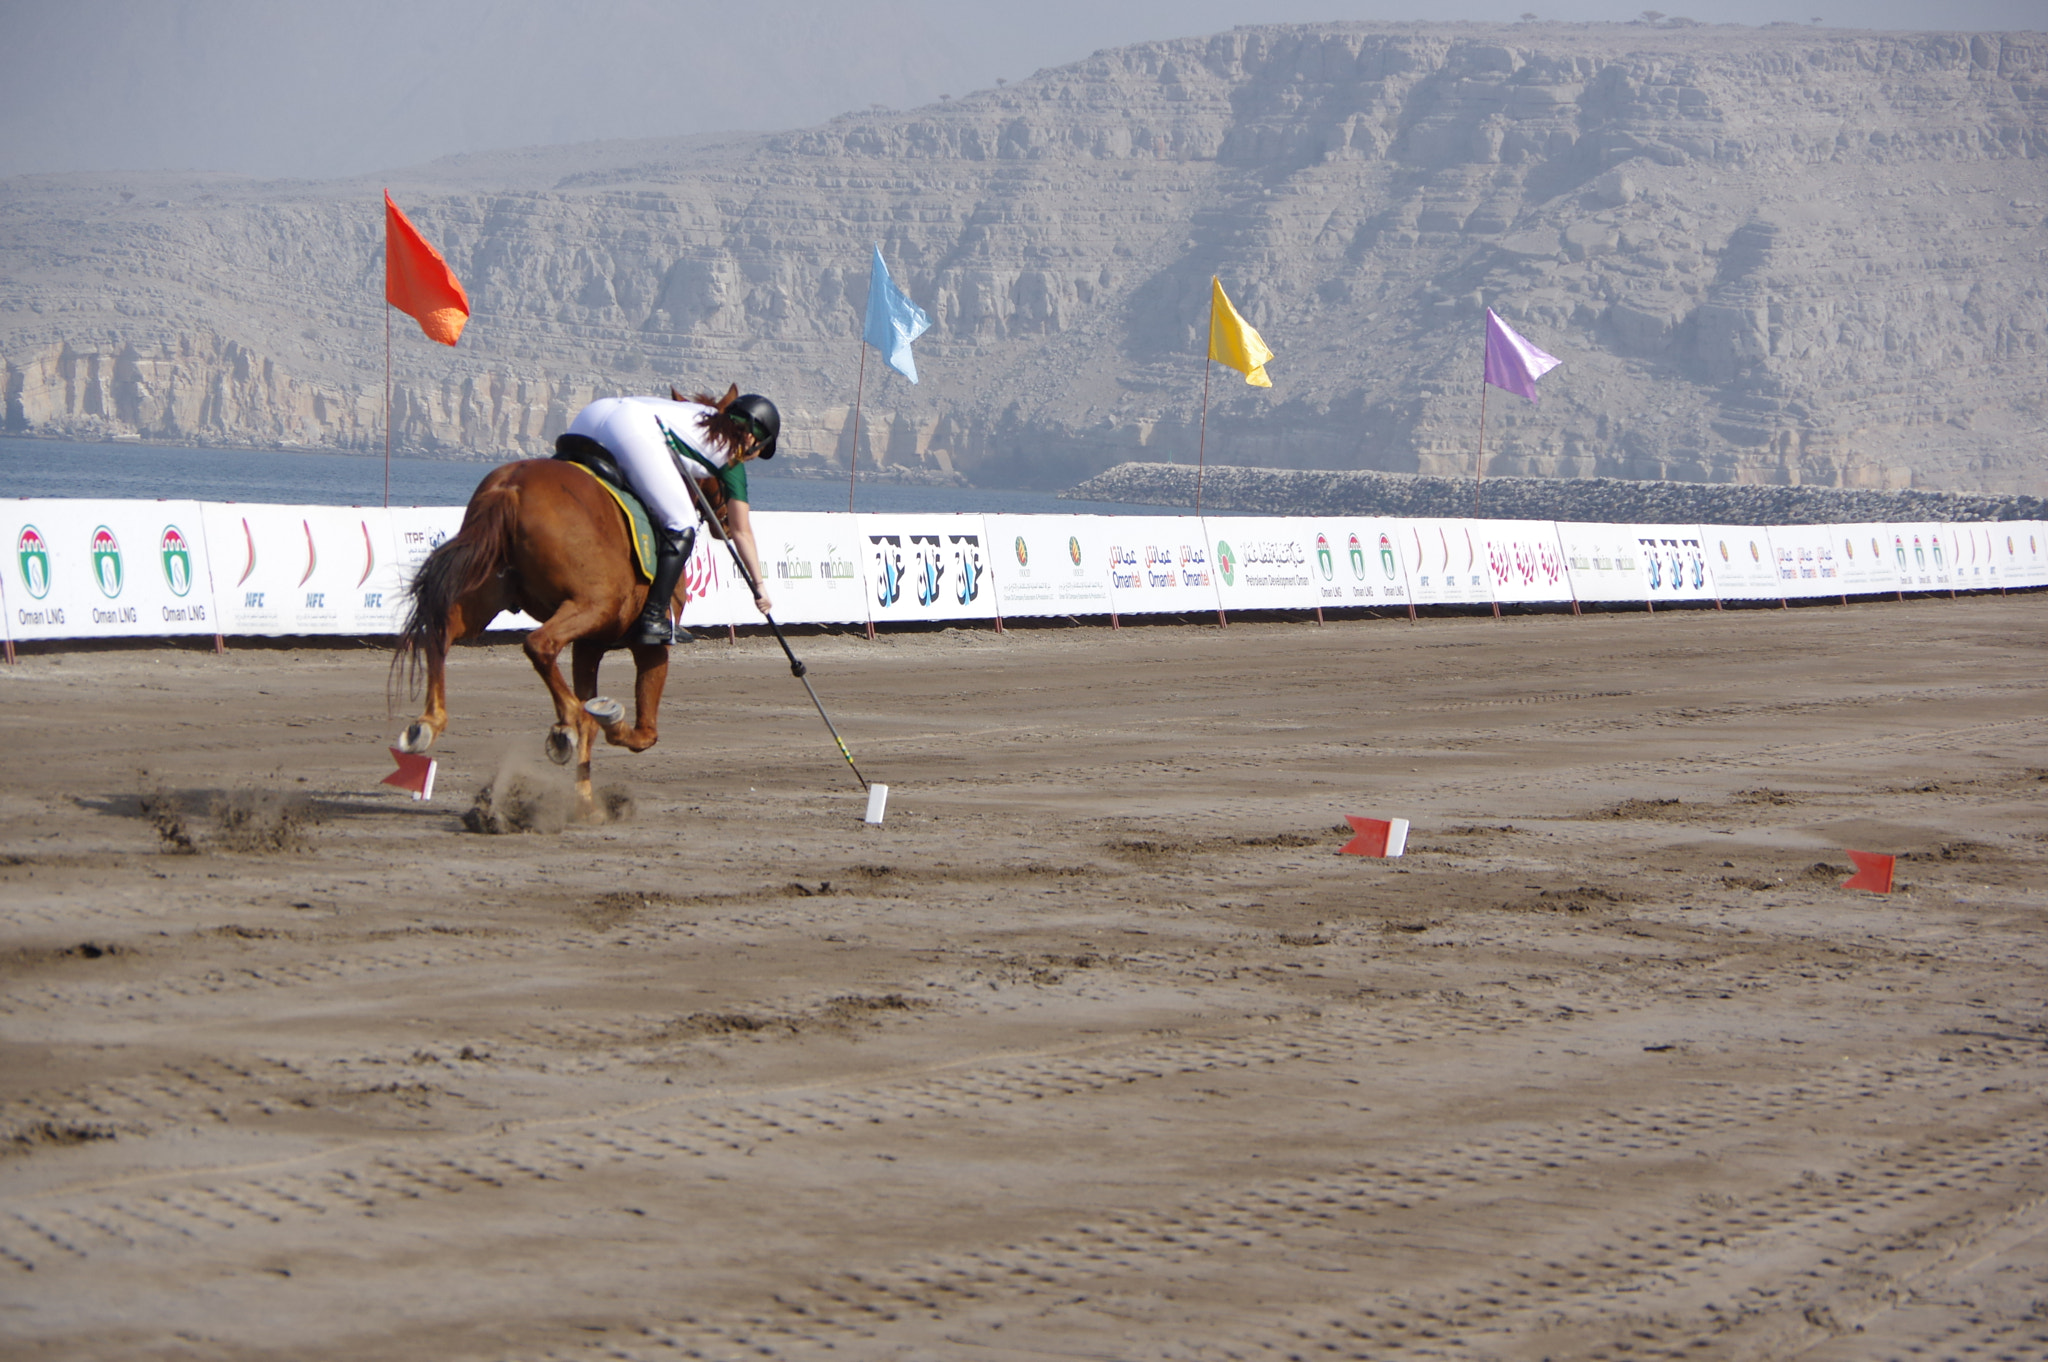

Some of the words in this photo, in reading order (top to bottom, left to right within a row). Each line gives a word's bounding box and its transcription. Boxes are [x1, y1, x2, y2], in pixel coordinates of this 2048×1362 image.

[404, 532, 425, 544] ITPF
[1112, 570, 1142, 589] Omantel
[1148, 570, 1177, 588] Omantel
[1182, 569, 1210, 587] Omantel
[1296, 574, 1310, 586] Oman
[244, 592, 265, 608] NFC
[306, 593, 325, 608] NFC
[364, 593, 382, 608] NFC
[18, 609, 44, 625] Oman
[45, 608, 65, 624] LNG
[92, 608, 117, 624] Oman
[118, 607, 137, 623] LNG
[162, 606, 187, 622] Oman
[187, 605, 206, 621] LNG
